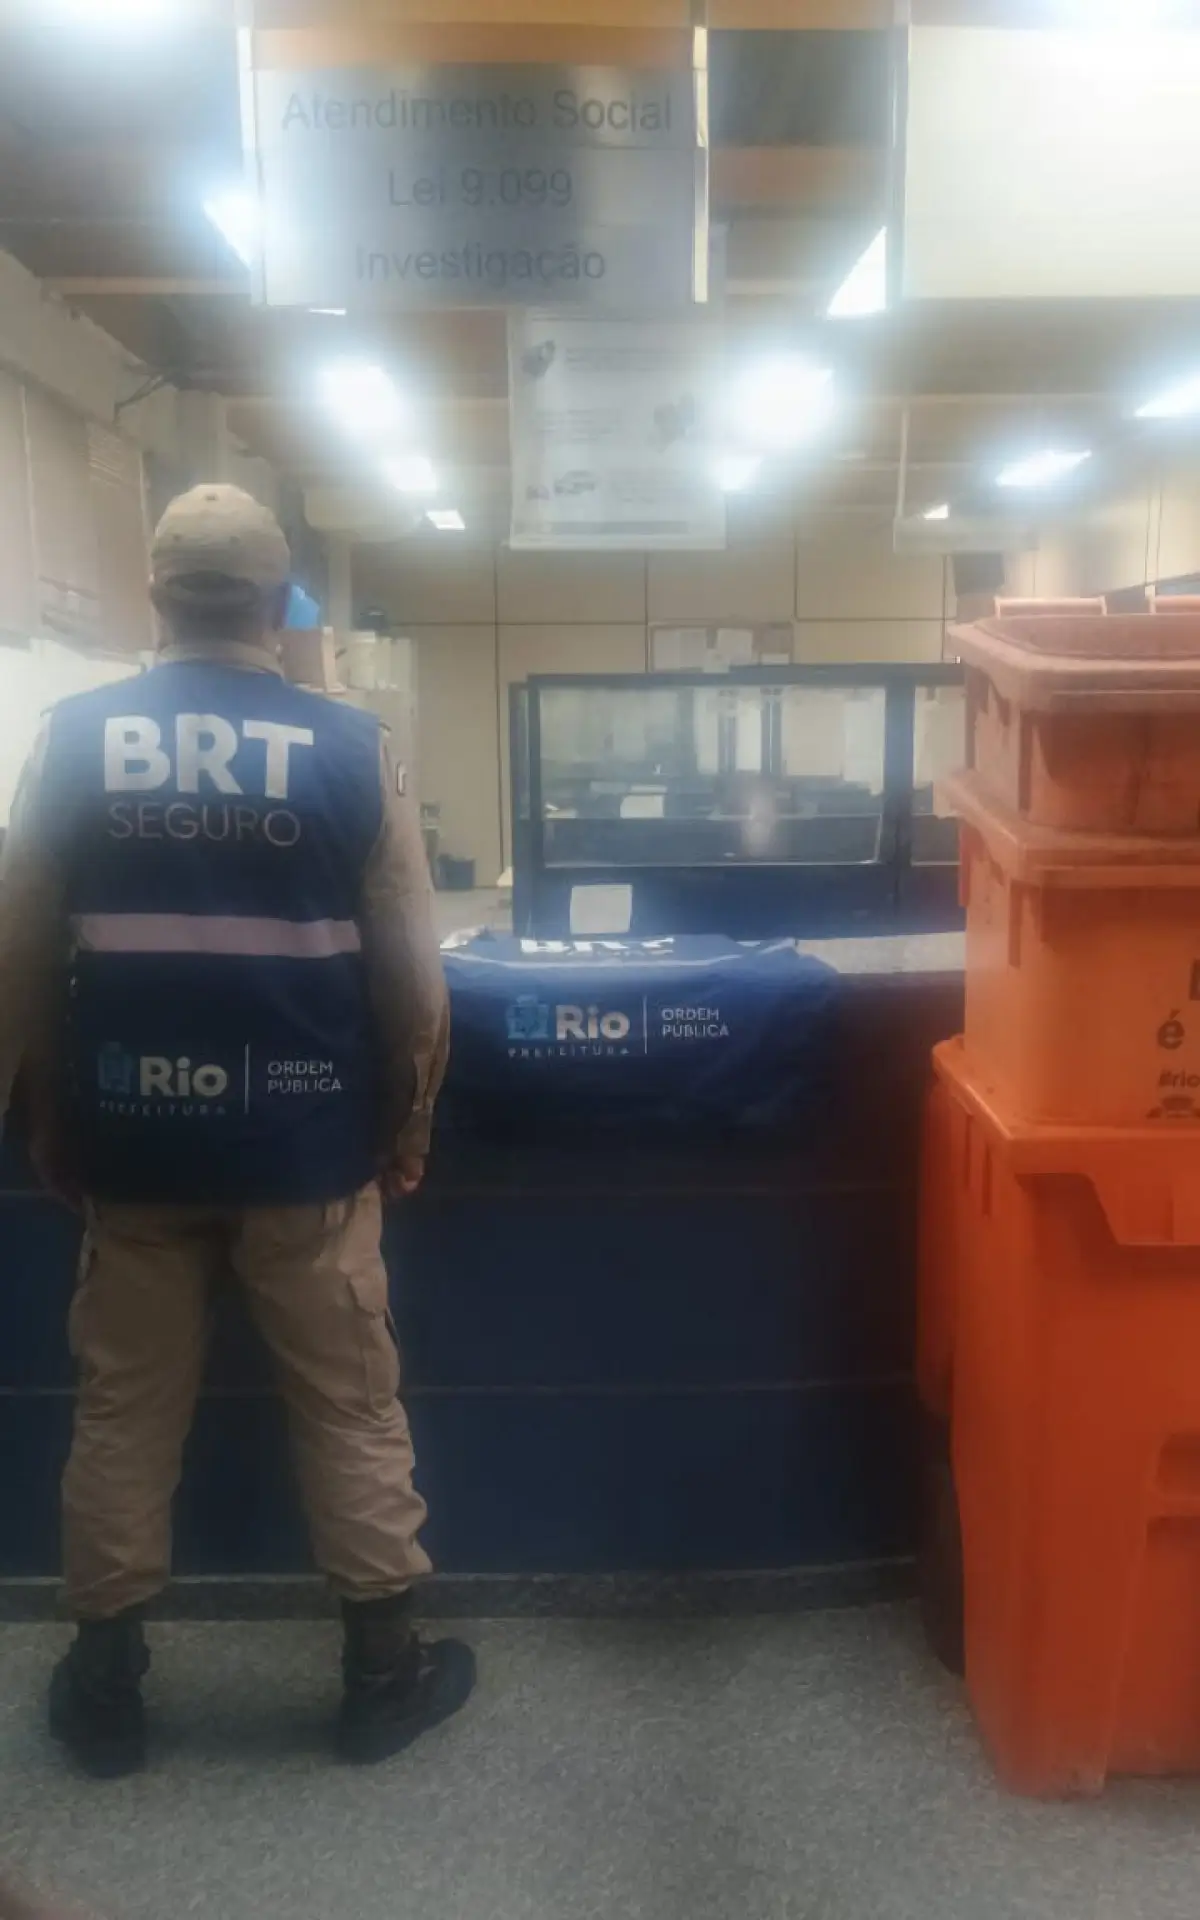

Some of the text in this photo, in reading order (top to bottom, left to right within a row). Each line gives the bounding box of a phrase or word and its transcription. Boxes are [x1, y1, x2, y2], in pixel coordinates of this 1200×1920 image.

[281, 89, 672, 131] Atendimento Social
[387, 167, 573, 207] Lei 9.099
[355, 241, 606, 288] Investigação
[104, 712, 315, 800] BRT
[107, 801, 302, 848] SEGURO
[555, 1003, 631, 1041] Rio
[660, 1007, 720, 1022] ORDEM
[1157, 1009, 1186, 1050] é
[138, 1055, 228, 1097] Rio
[267, 1060, 334, 1077] ORDEM
